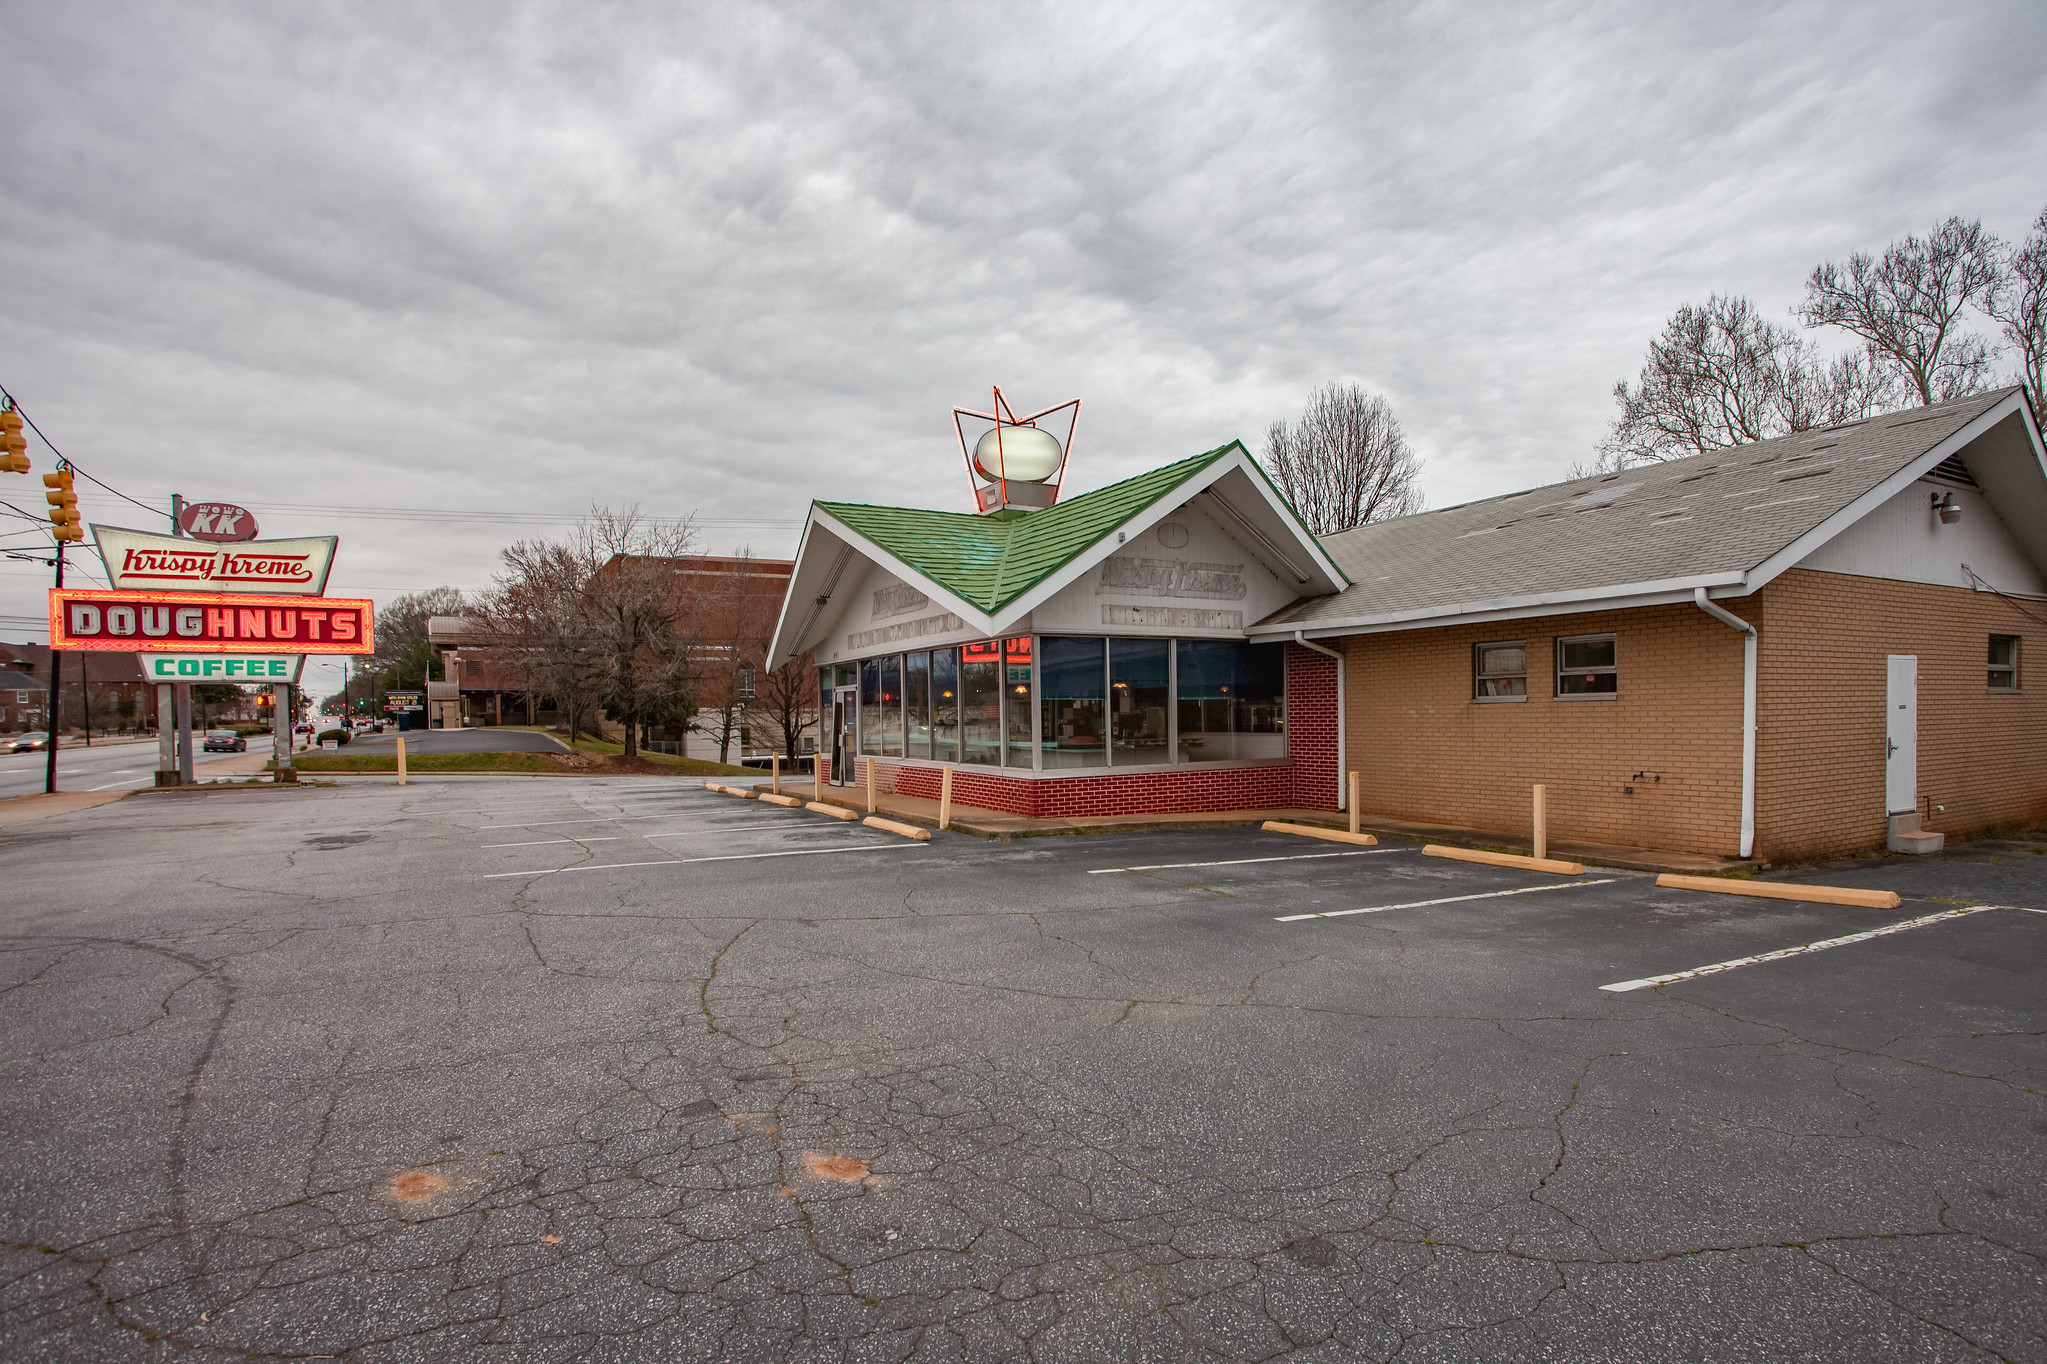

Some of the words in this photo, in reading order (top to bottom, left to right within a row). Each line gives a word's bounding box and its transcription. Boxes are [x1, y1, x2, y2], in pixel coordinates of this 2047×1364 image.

[189, 512, 245, 536] KK
[122, 549, 218, 580] Krispy
[220, 553, 310, 577] Kreme
[71, 604, 356, 640] DOUGHNUTS
[154, 658, 288, 677] COFFEE
